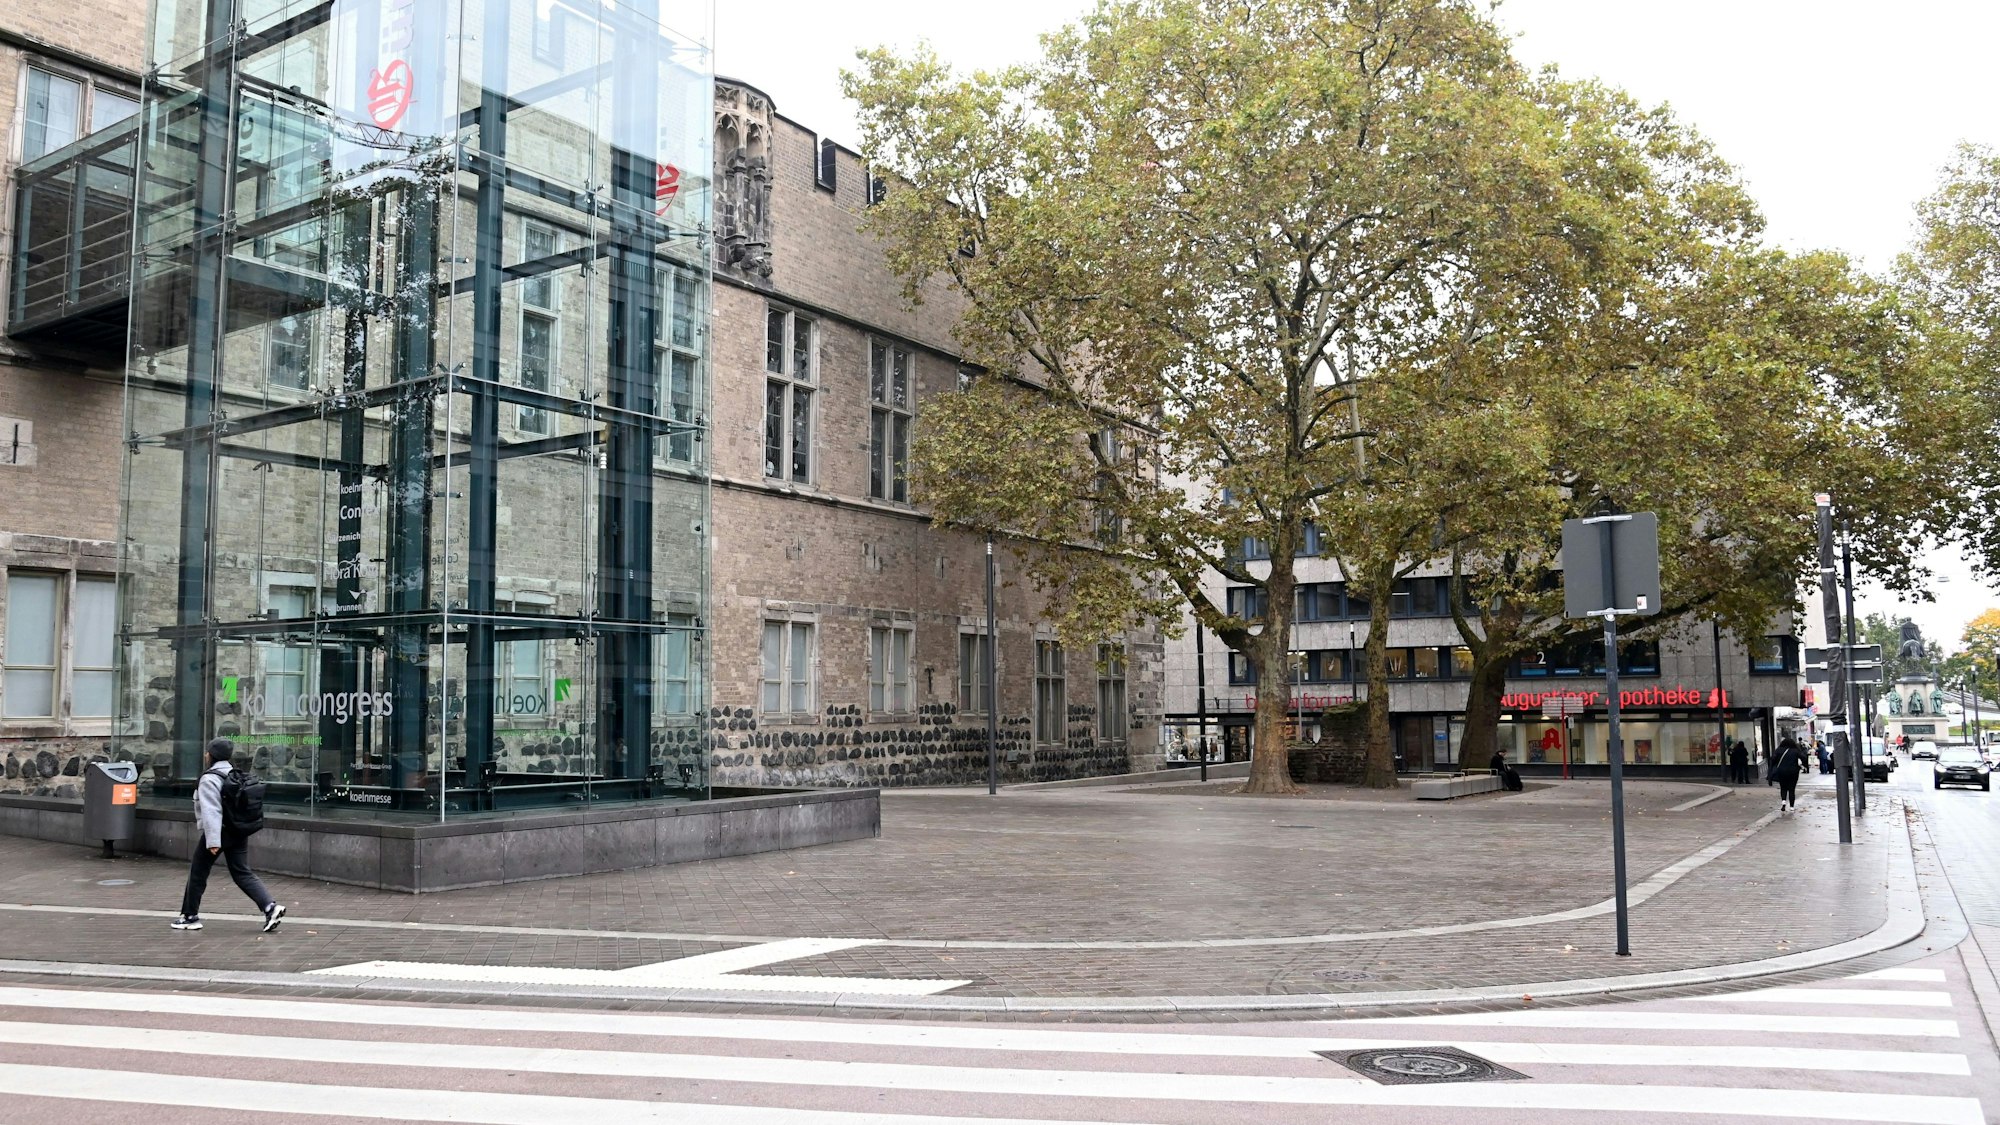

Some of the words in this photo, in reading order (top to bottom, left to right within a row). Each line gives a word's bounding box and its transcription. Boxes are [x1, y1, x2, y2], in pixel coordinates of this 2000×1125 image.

[1536, 651, 1547, 665] 2
[243, 686, 393, 724] koncongress
[1606, 684, 1701, 709] potheke
[350, 790, 391, 804] koelnmesse
